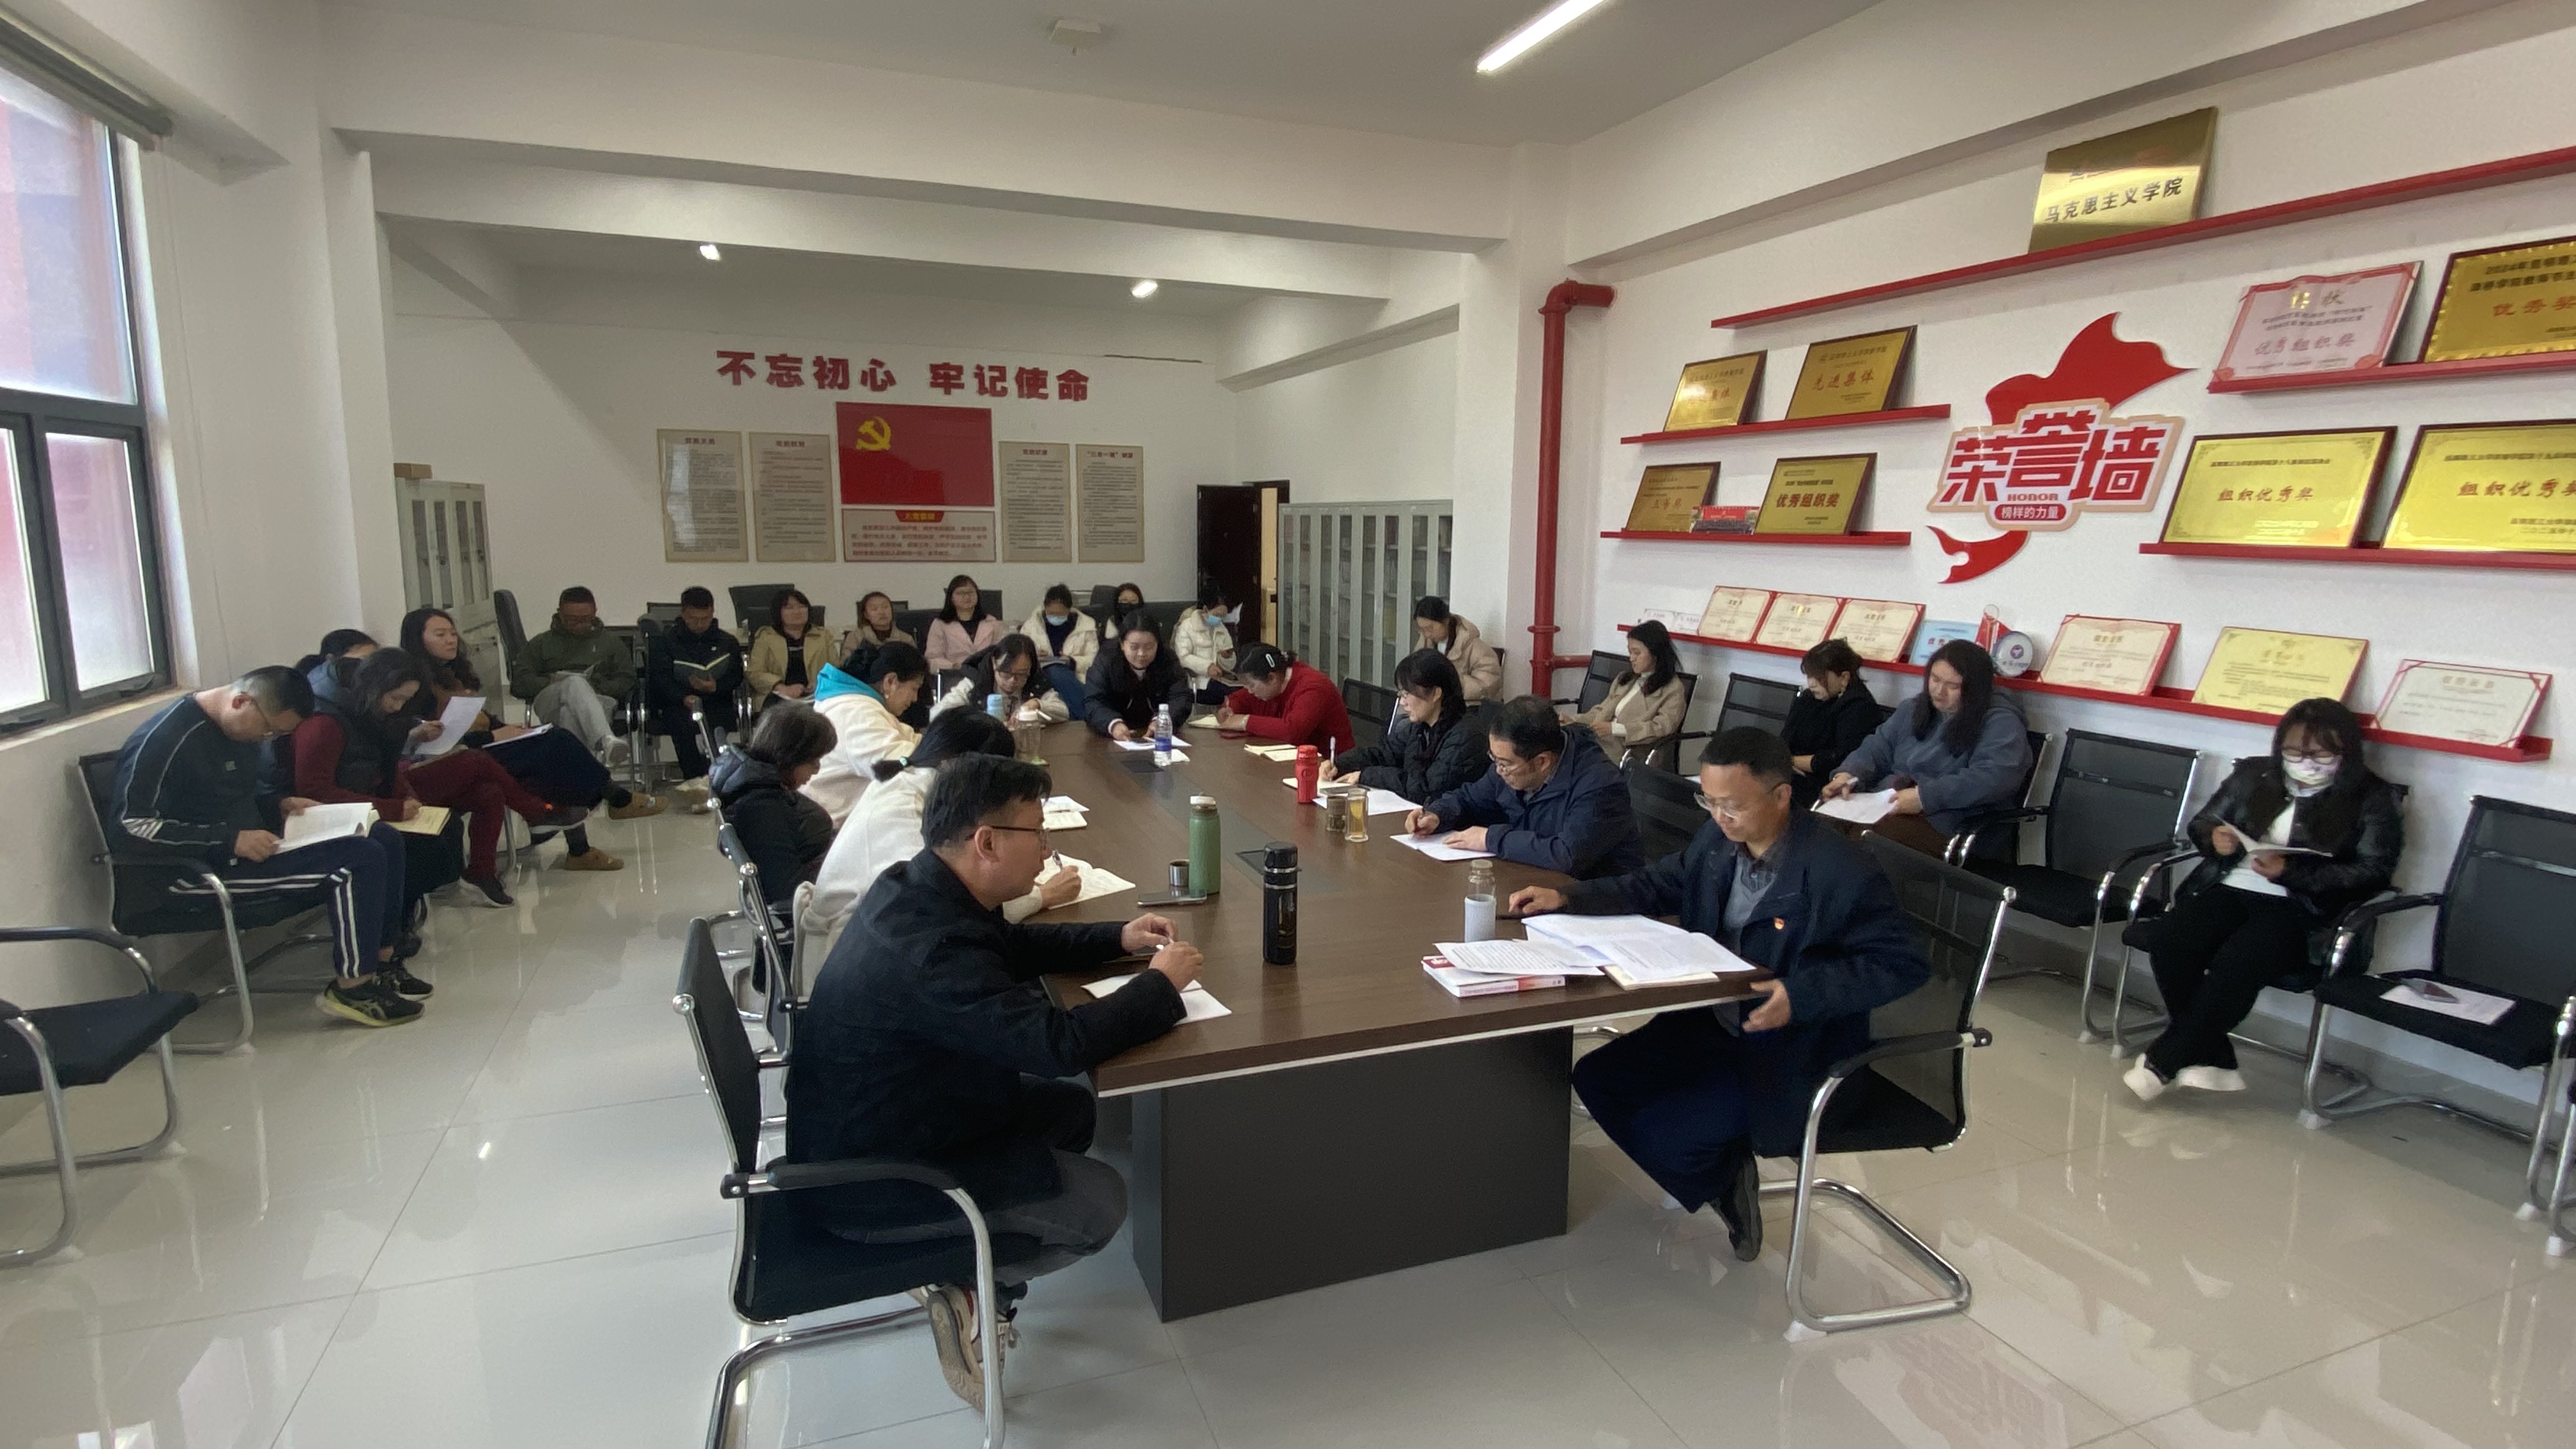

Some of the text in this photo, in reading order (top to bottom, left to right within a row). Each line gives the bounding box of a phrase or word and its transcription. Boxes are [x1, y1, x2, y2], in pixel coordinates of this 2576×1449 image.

[2045, 176, 2183, 223] 马克思主义学院
[716, 350, 1089, 401] 不忘初心 牢记使命
[1939, 410, 2167, 502] 荣誉墙
[2218, 486, 2314, 502] 组织优秀奖
[2457, 479, 2576, 498] 组织优秀奖
[1776, 493, 1840, 508] 优秀组织奖
[2001, 505, 2058, 519] 榜样的力量
